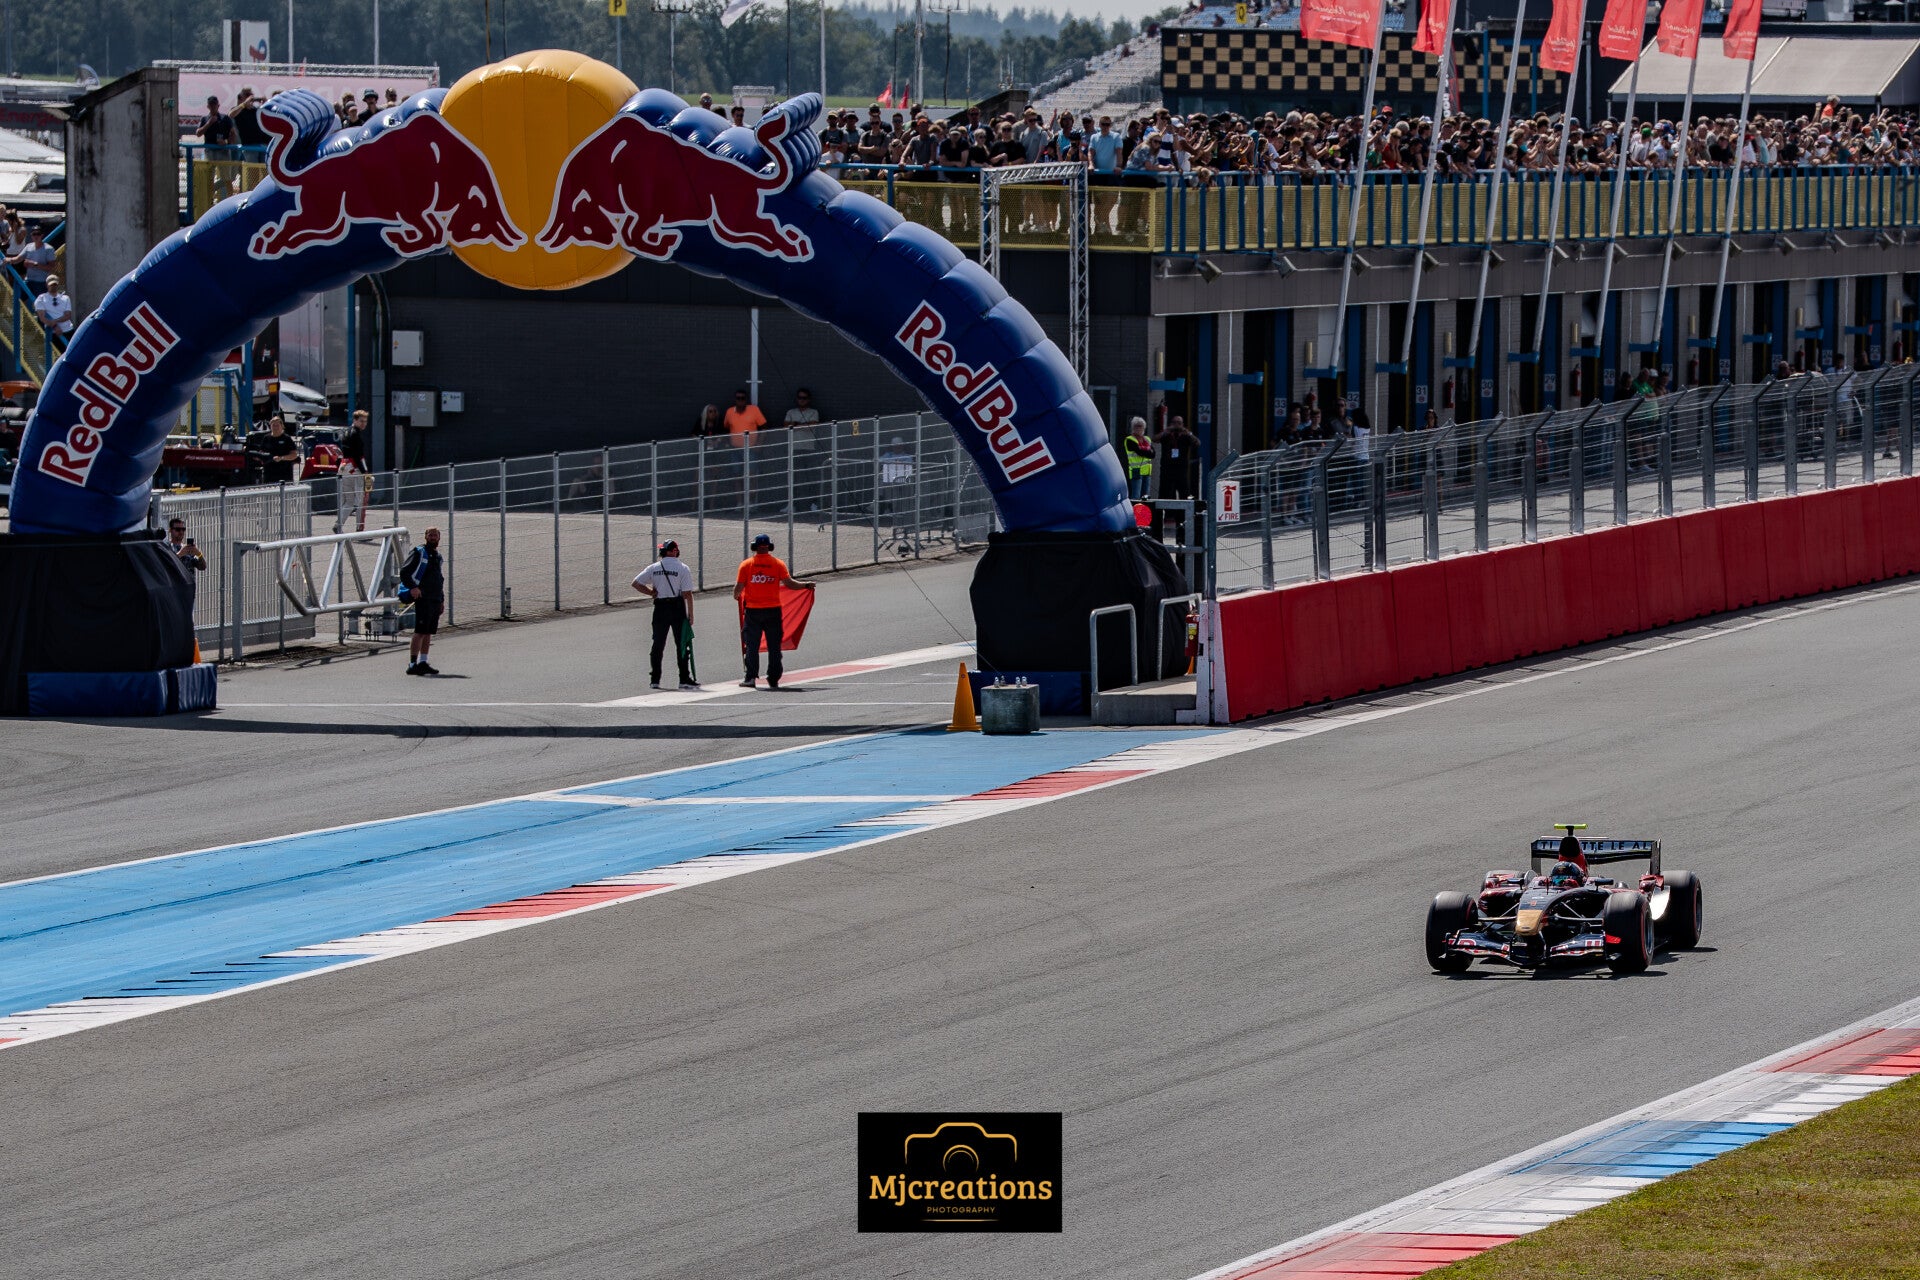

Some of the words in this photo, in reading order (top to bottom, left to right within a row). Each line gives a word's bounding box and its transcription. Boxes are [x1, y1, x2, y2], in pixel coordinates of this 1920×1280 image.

[1719, 360, 1730, 368] 26
[1544, 375, 1555, 384] 29
[1481, 381, 1493, 389] 30
[38, 378, 122, 488] Red
[84, 301, 181, 404] Bull
[895, 300, 999, 404] Red
[964, 379, 1056, 484] Bull
[1416, 386, 1427, 395] 31
[1347, 393, 1359, 401] 32
[1274, 399, 1286, 408] 33
[1198, 404, 1210, 414] 34
[1224, 512, 1239, 520] FIRE
[750, 574, 767, 584] 100
[1611, 841, 1625, 851] LE
